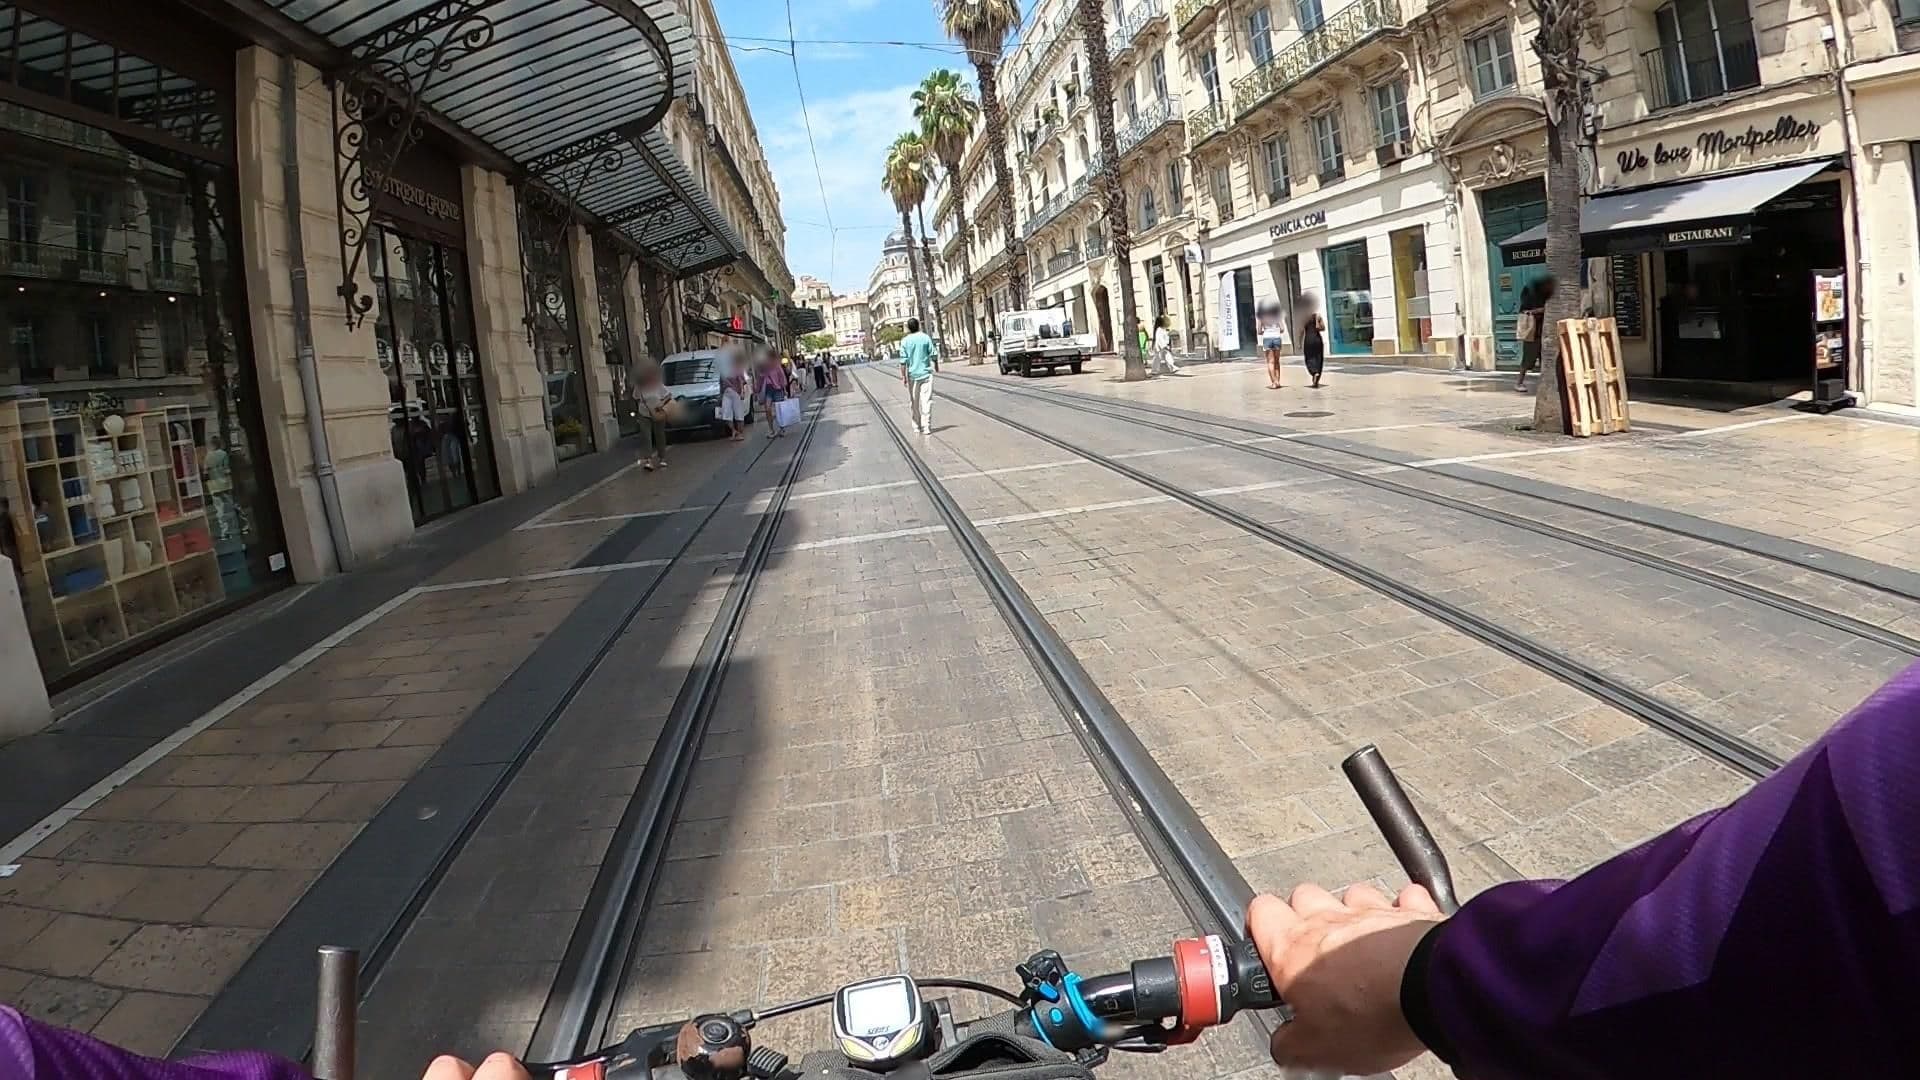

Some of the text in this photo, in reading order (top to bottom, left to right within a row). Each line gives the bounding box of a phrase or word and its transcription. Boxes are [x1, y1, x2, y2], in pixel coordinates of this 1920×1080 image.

[1617, 115, 1821, 174] We love Montpellier
[1668, 226, 1734, 242] RESTAURANT
